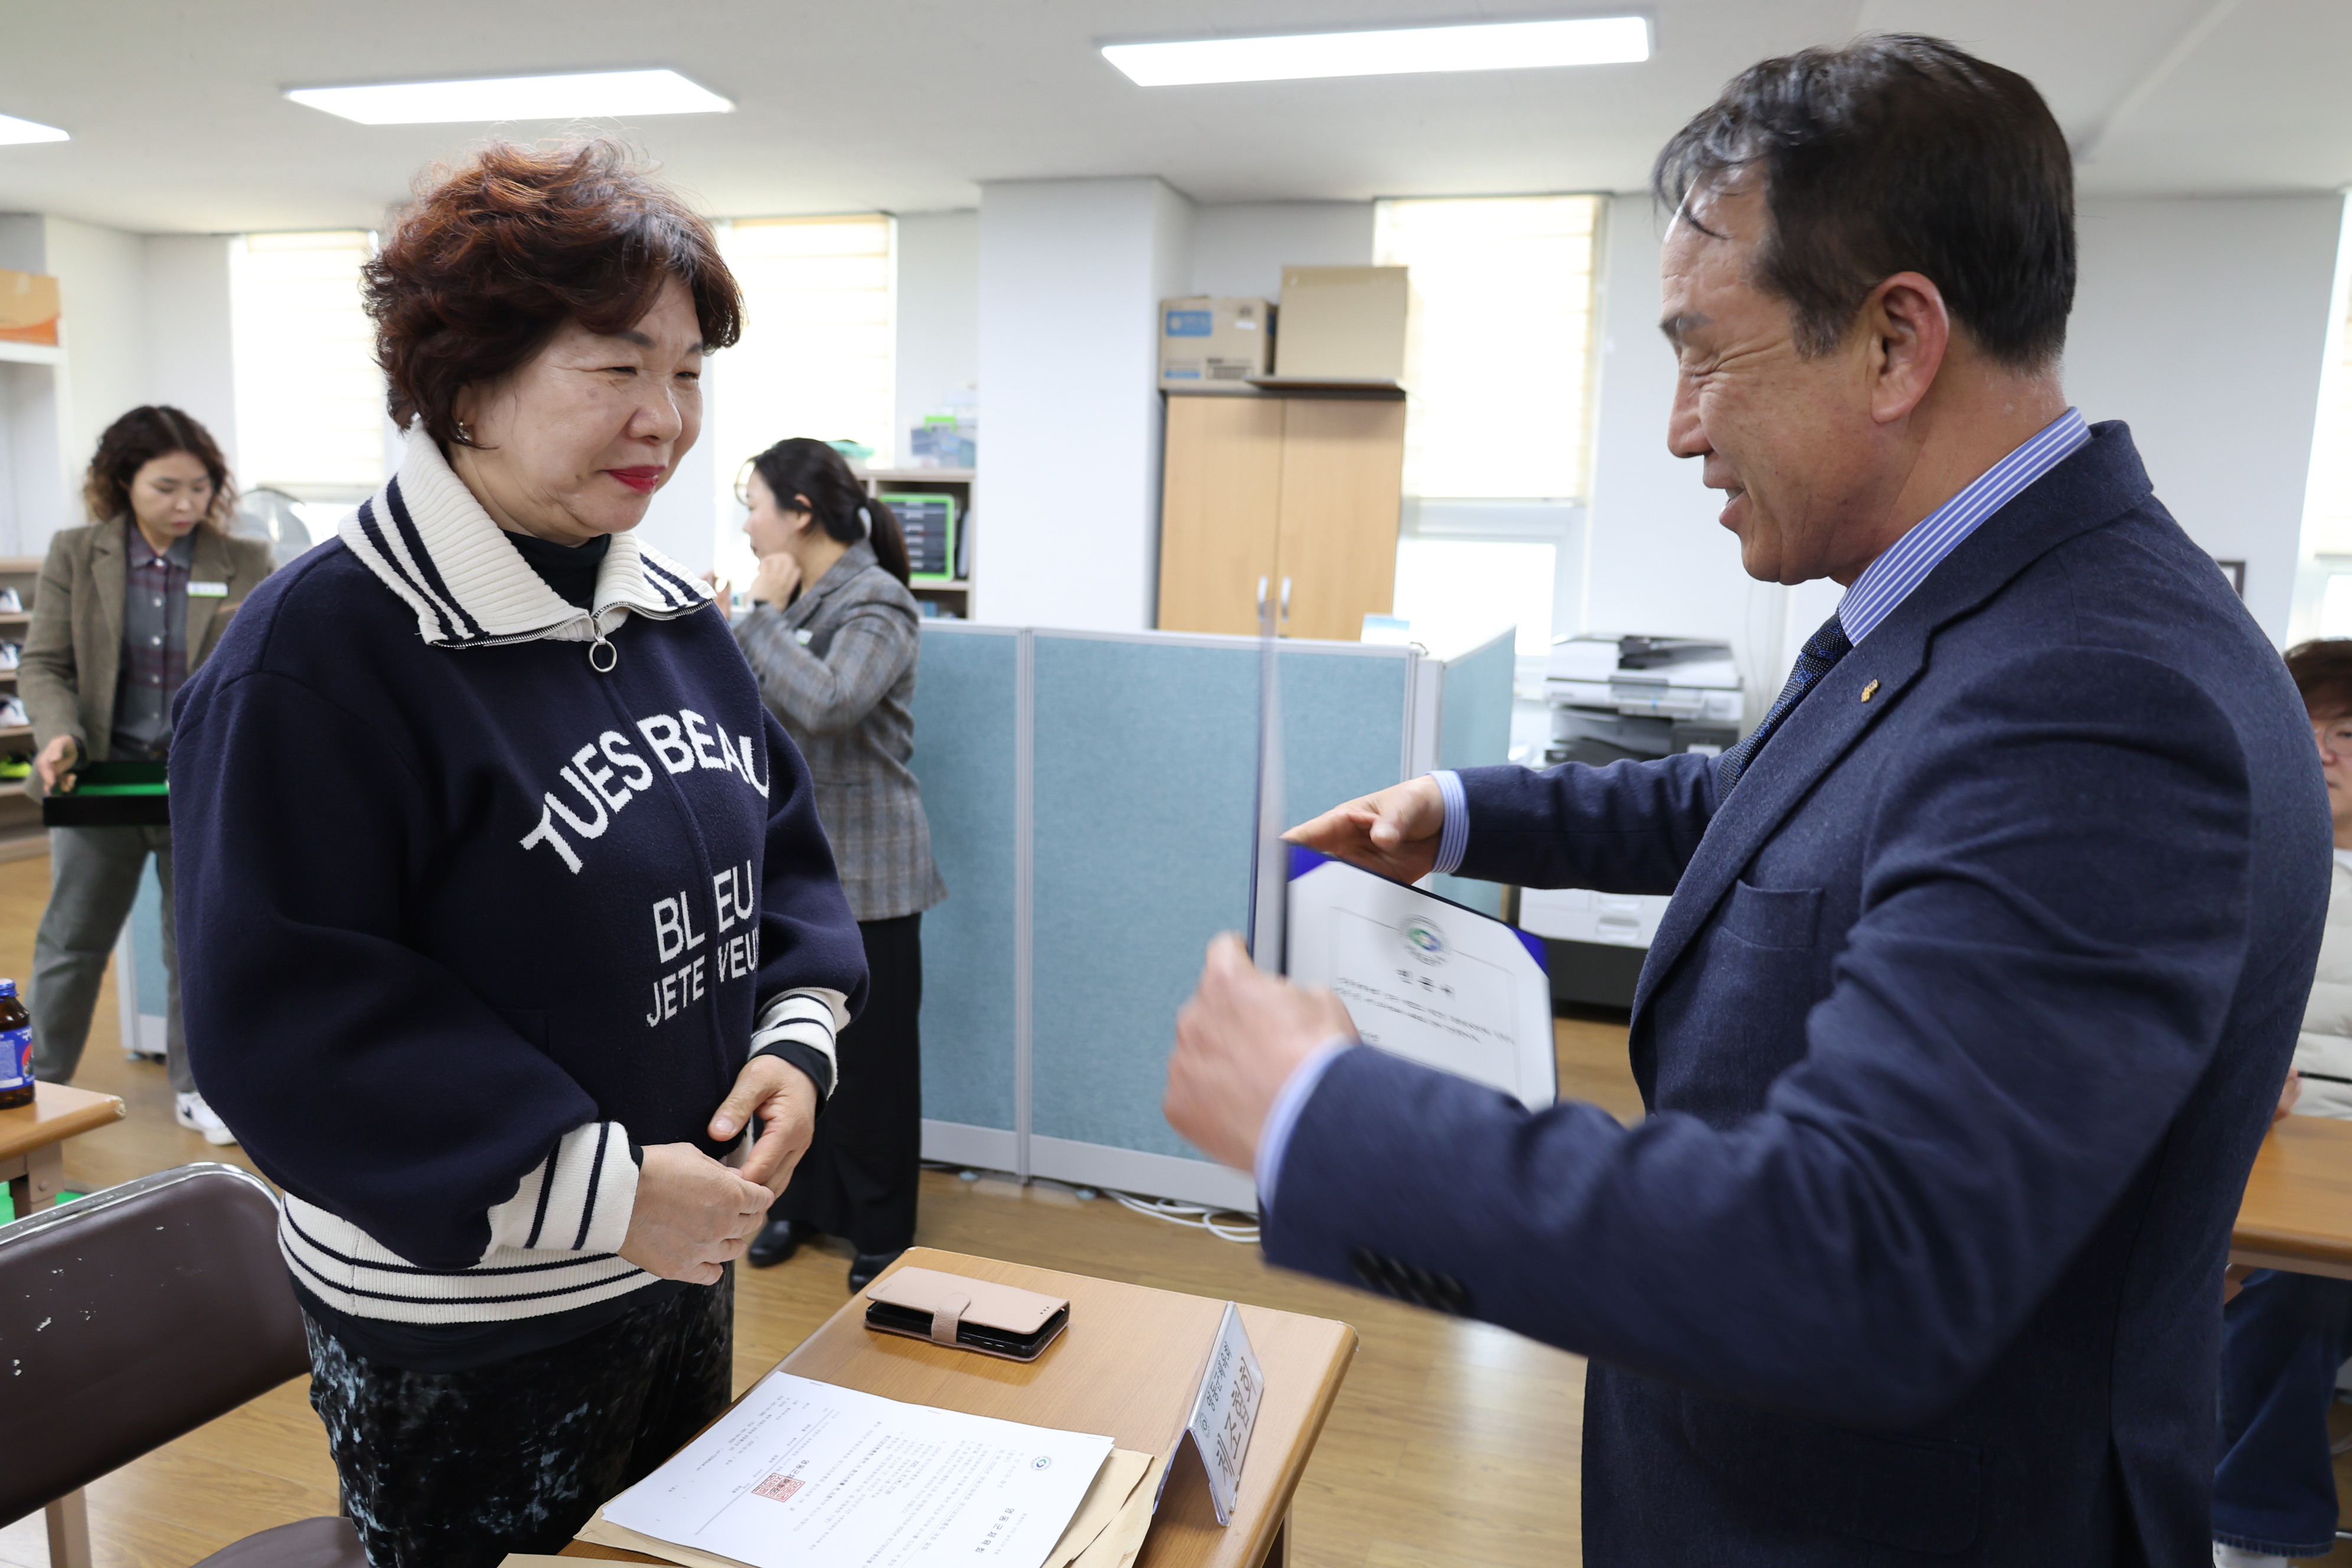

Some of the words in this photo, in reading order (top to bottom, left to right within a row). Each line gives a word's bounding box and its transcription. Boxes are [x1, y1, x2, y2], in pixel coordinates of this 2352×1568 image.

[519, 730, 654, 874] TUES
[1207, 1341, 1233, 1412] 영동군체육회
[1216, 1356, 1257, 1487] 체조협회
[973, 1506, 1015, 1554] 영동군체육회
